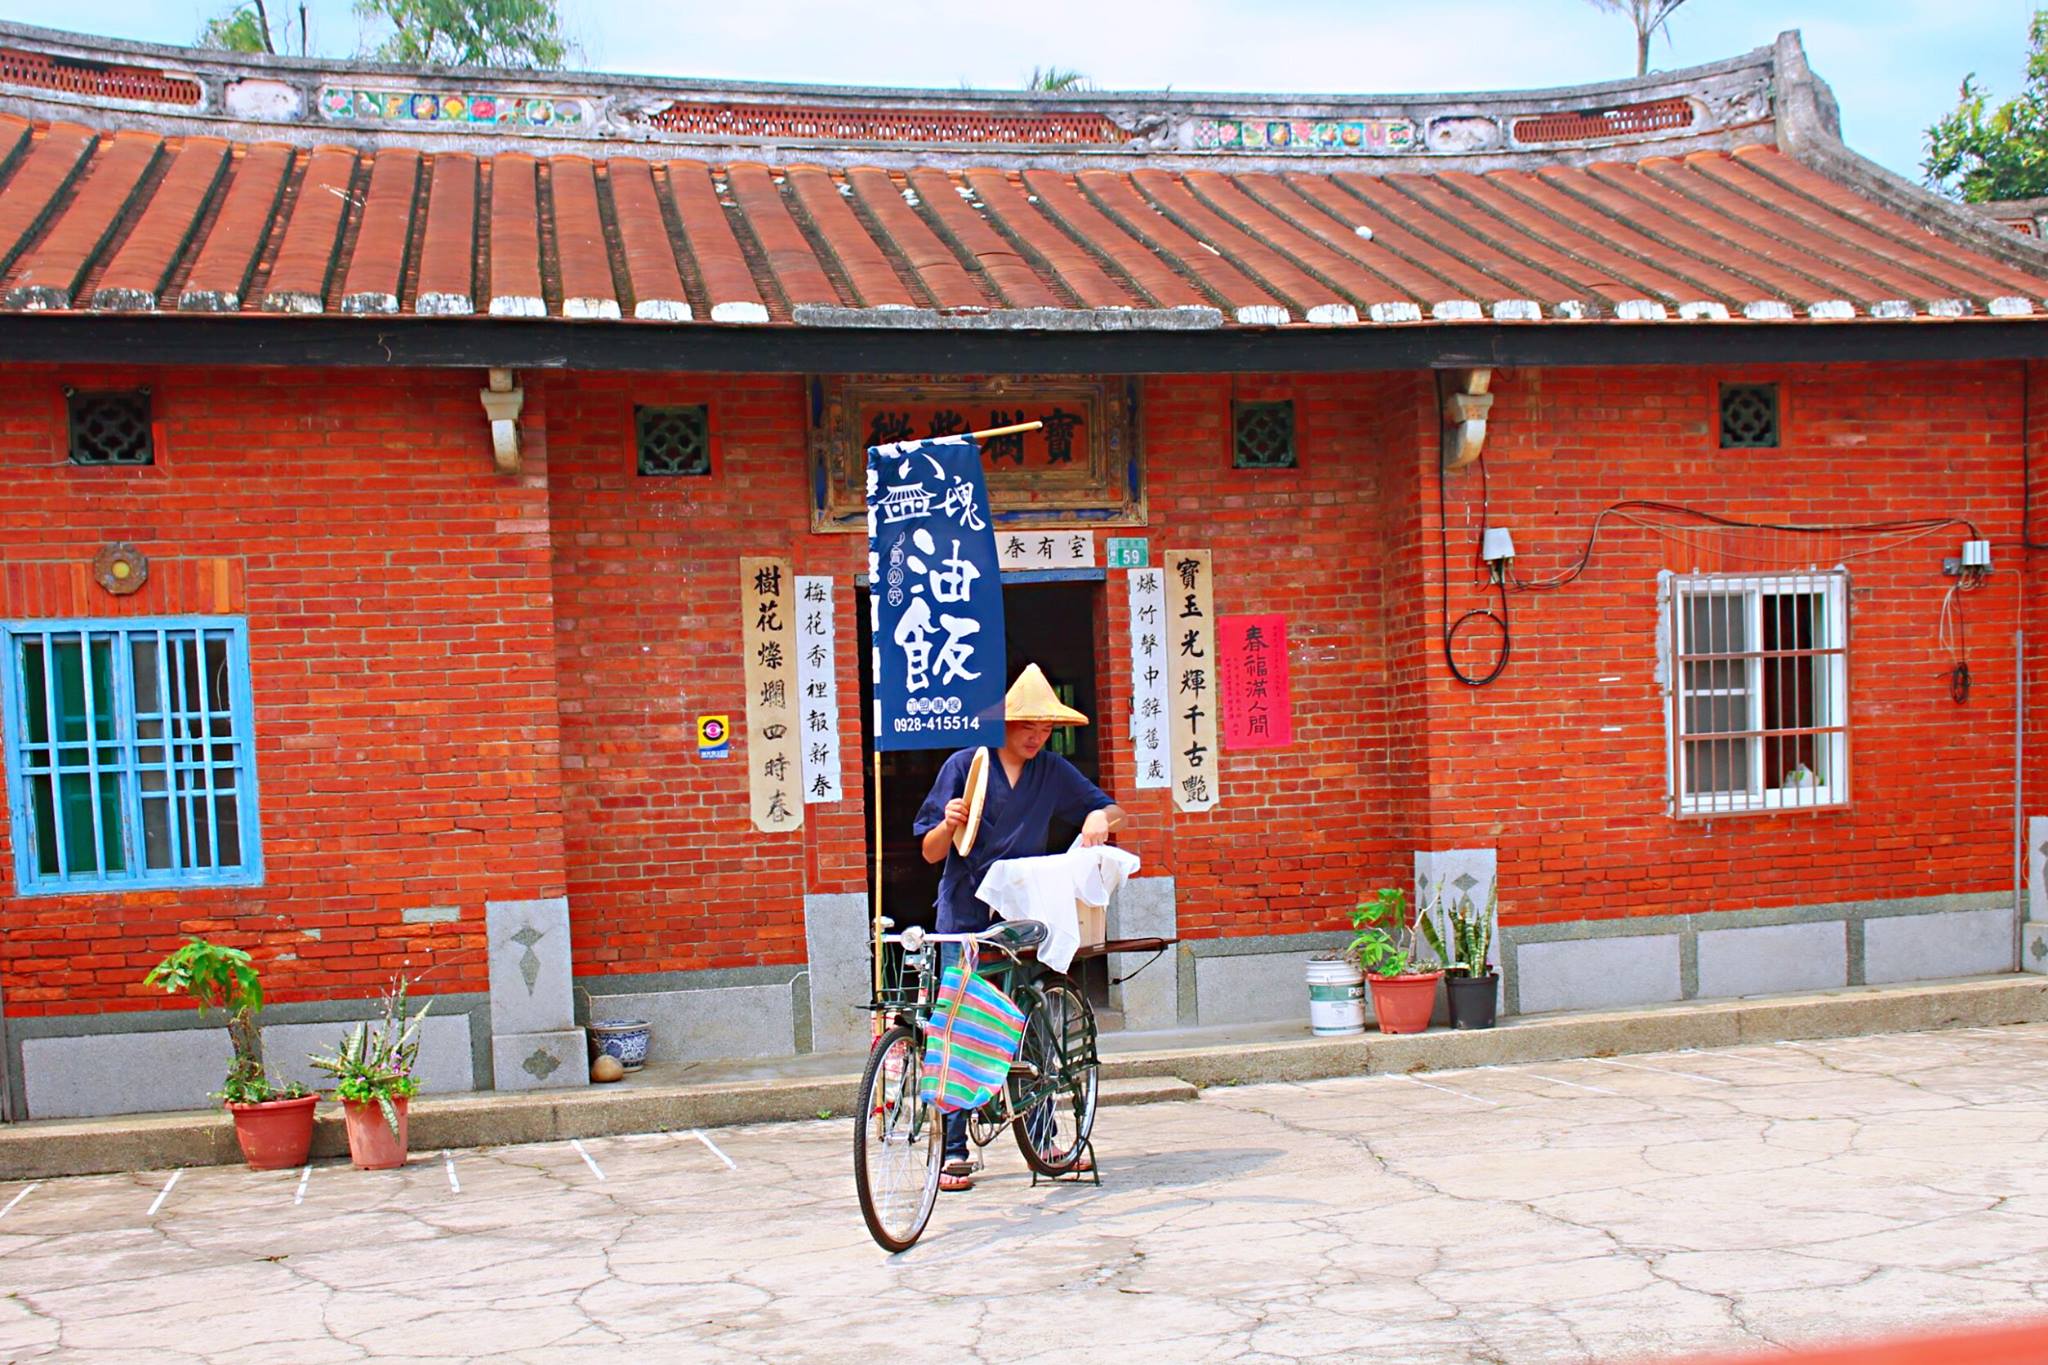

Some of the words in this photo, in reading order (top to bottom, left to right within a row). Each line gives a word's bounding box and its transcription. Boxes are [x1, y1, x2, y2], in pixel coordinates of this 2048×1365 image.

[1123, 550, 1140, 565] 59
[753, 565, 794, 823] 樹花燦爛四時春
[804, 581, 832, 798] 梅花香裡報新春
[894, 716, 980, 732] 0928-415514
[1242, 625, 1270, 738] 春福滿人間
